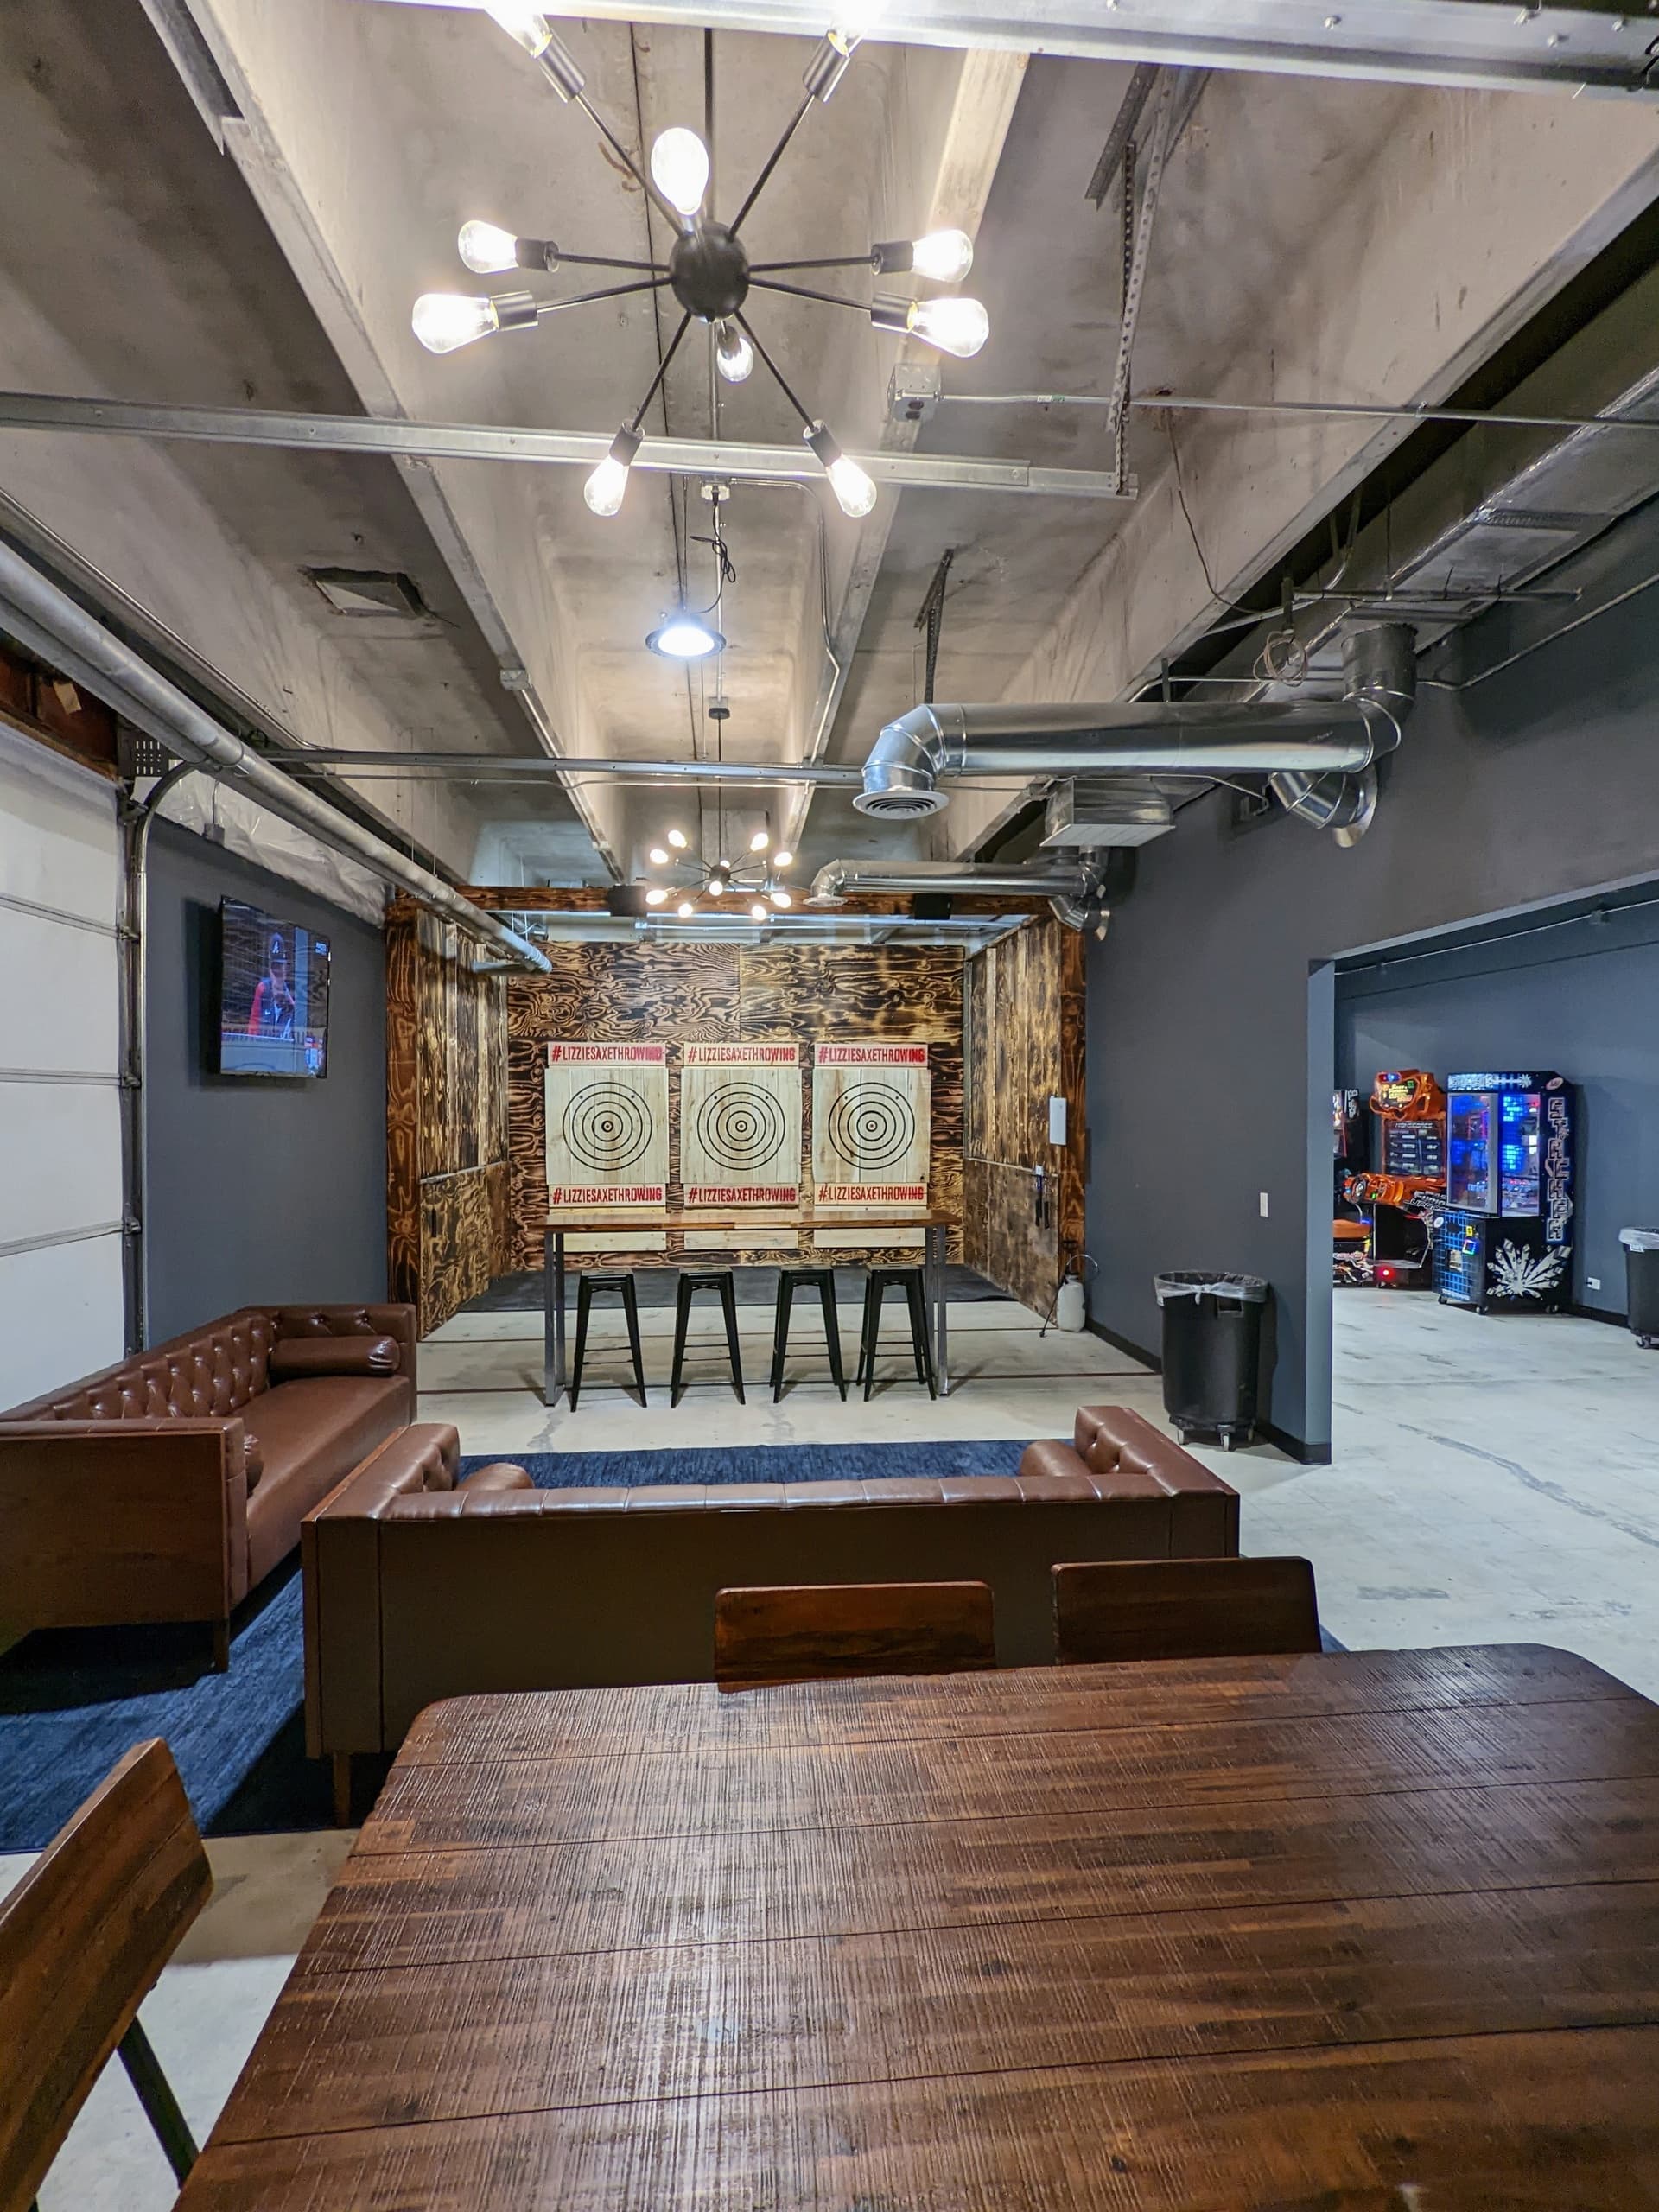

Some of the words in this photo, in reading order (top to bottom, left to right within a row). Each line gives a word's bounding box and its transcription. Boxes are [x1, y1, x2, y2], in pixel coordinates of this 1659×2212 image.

[552, 1045, 663, 1062] #LIZZIESAXETHROWING
[688, 1046, 796, 1063] #LIZZIESAXETHROWING
[818, 1046, 925, 1063] #LIZZIESAXETHROWING
[552, 1187, 663, 1204] #LIZZIESAXETHROWING
[688, 1187, 796, 1204] #LIZZIESAXETHROWING
[818, 1184, 925, 1202] #LIZZIESAXETHROWING
